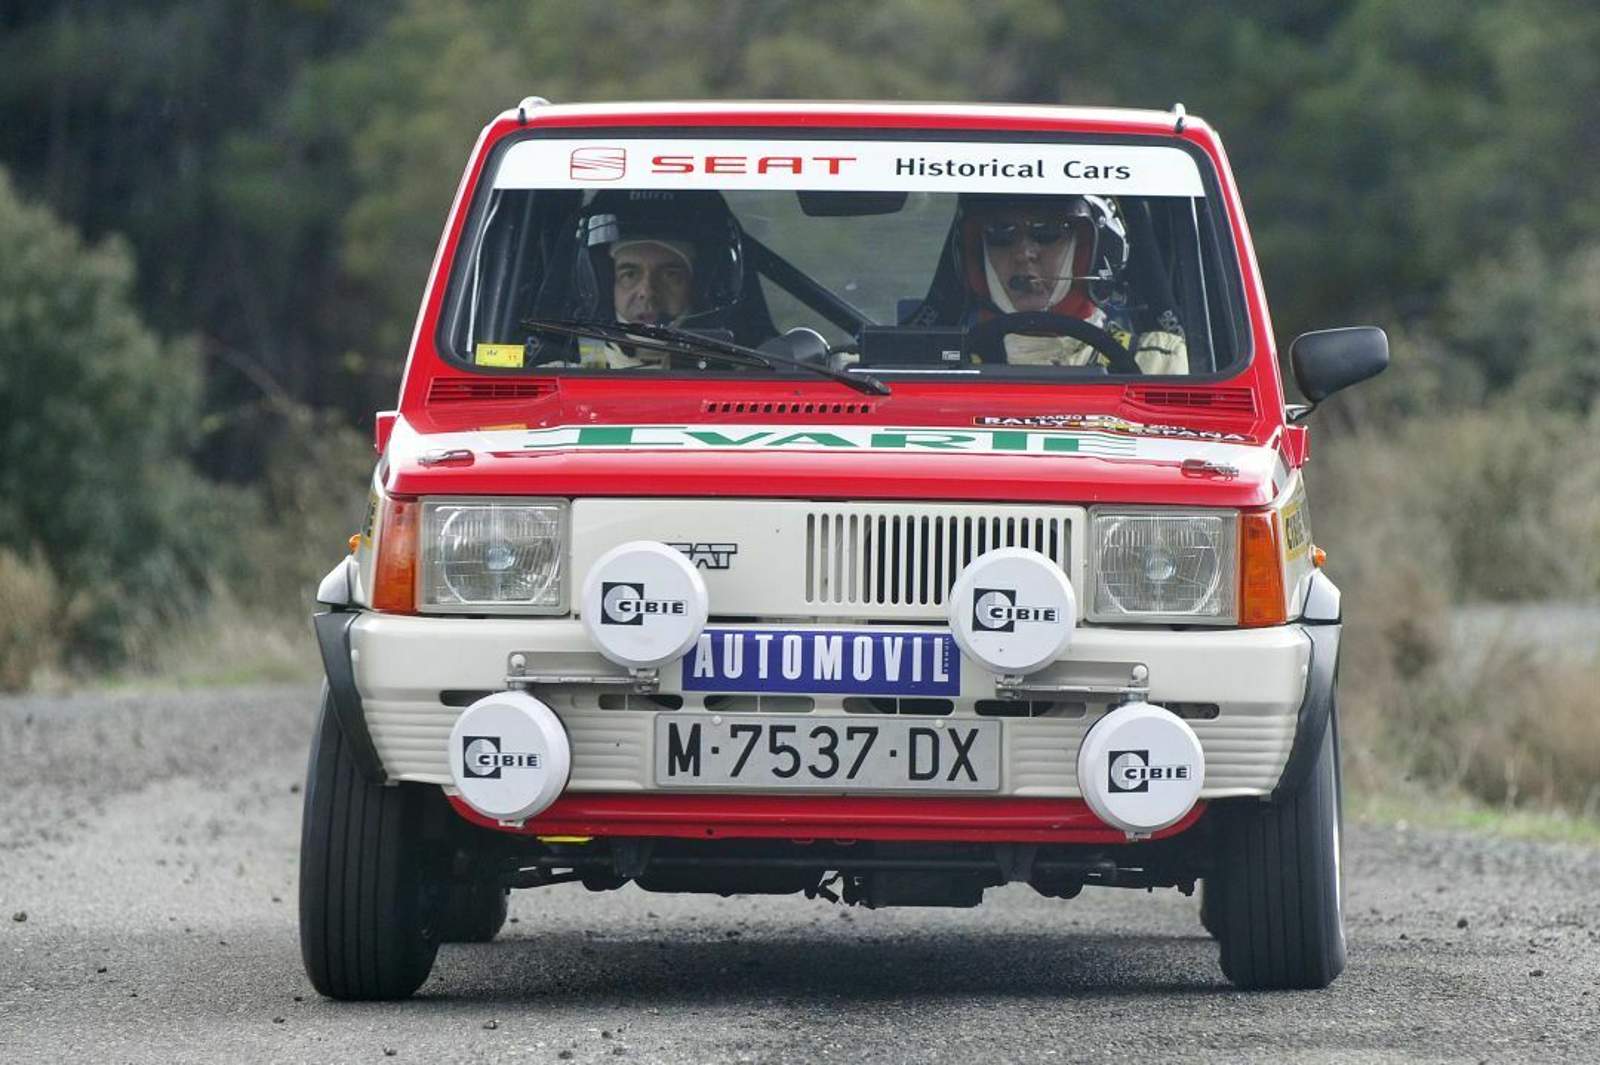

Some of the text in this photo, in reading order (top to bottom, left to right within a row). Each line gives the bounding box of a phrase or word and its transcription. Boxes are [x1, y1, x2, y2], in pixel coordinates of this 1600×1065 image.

[652, 155, 1131, 181] SEAT Historical Cars
[984, 416, 1068, 427] RALLY
[693, 633, 948, 683] AUTOMOVIL
